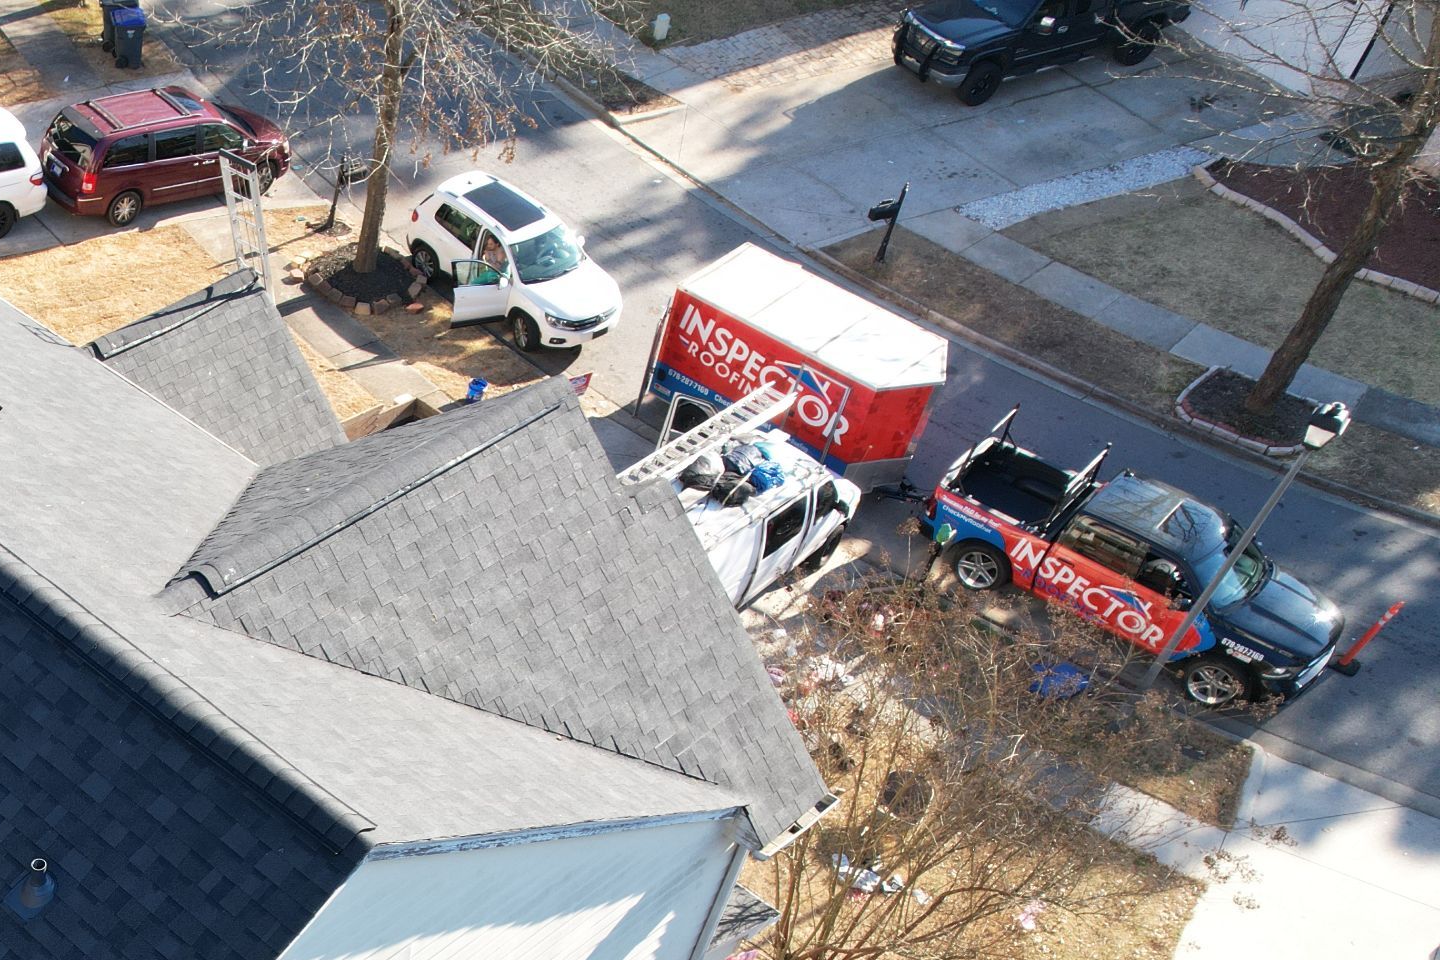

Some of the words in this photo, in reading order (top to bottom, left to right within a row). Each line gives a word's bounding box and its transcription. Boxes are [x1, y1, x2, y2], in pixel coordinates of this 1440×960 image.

[679, 304, 849, 445] INSPECTOR
[687, 342, 759, 396] ROOFIN
[1010, 538, 1164, 647] INSPECTOR
[1221, 637, 1265, 661] 678-287-7169
